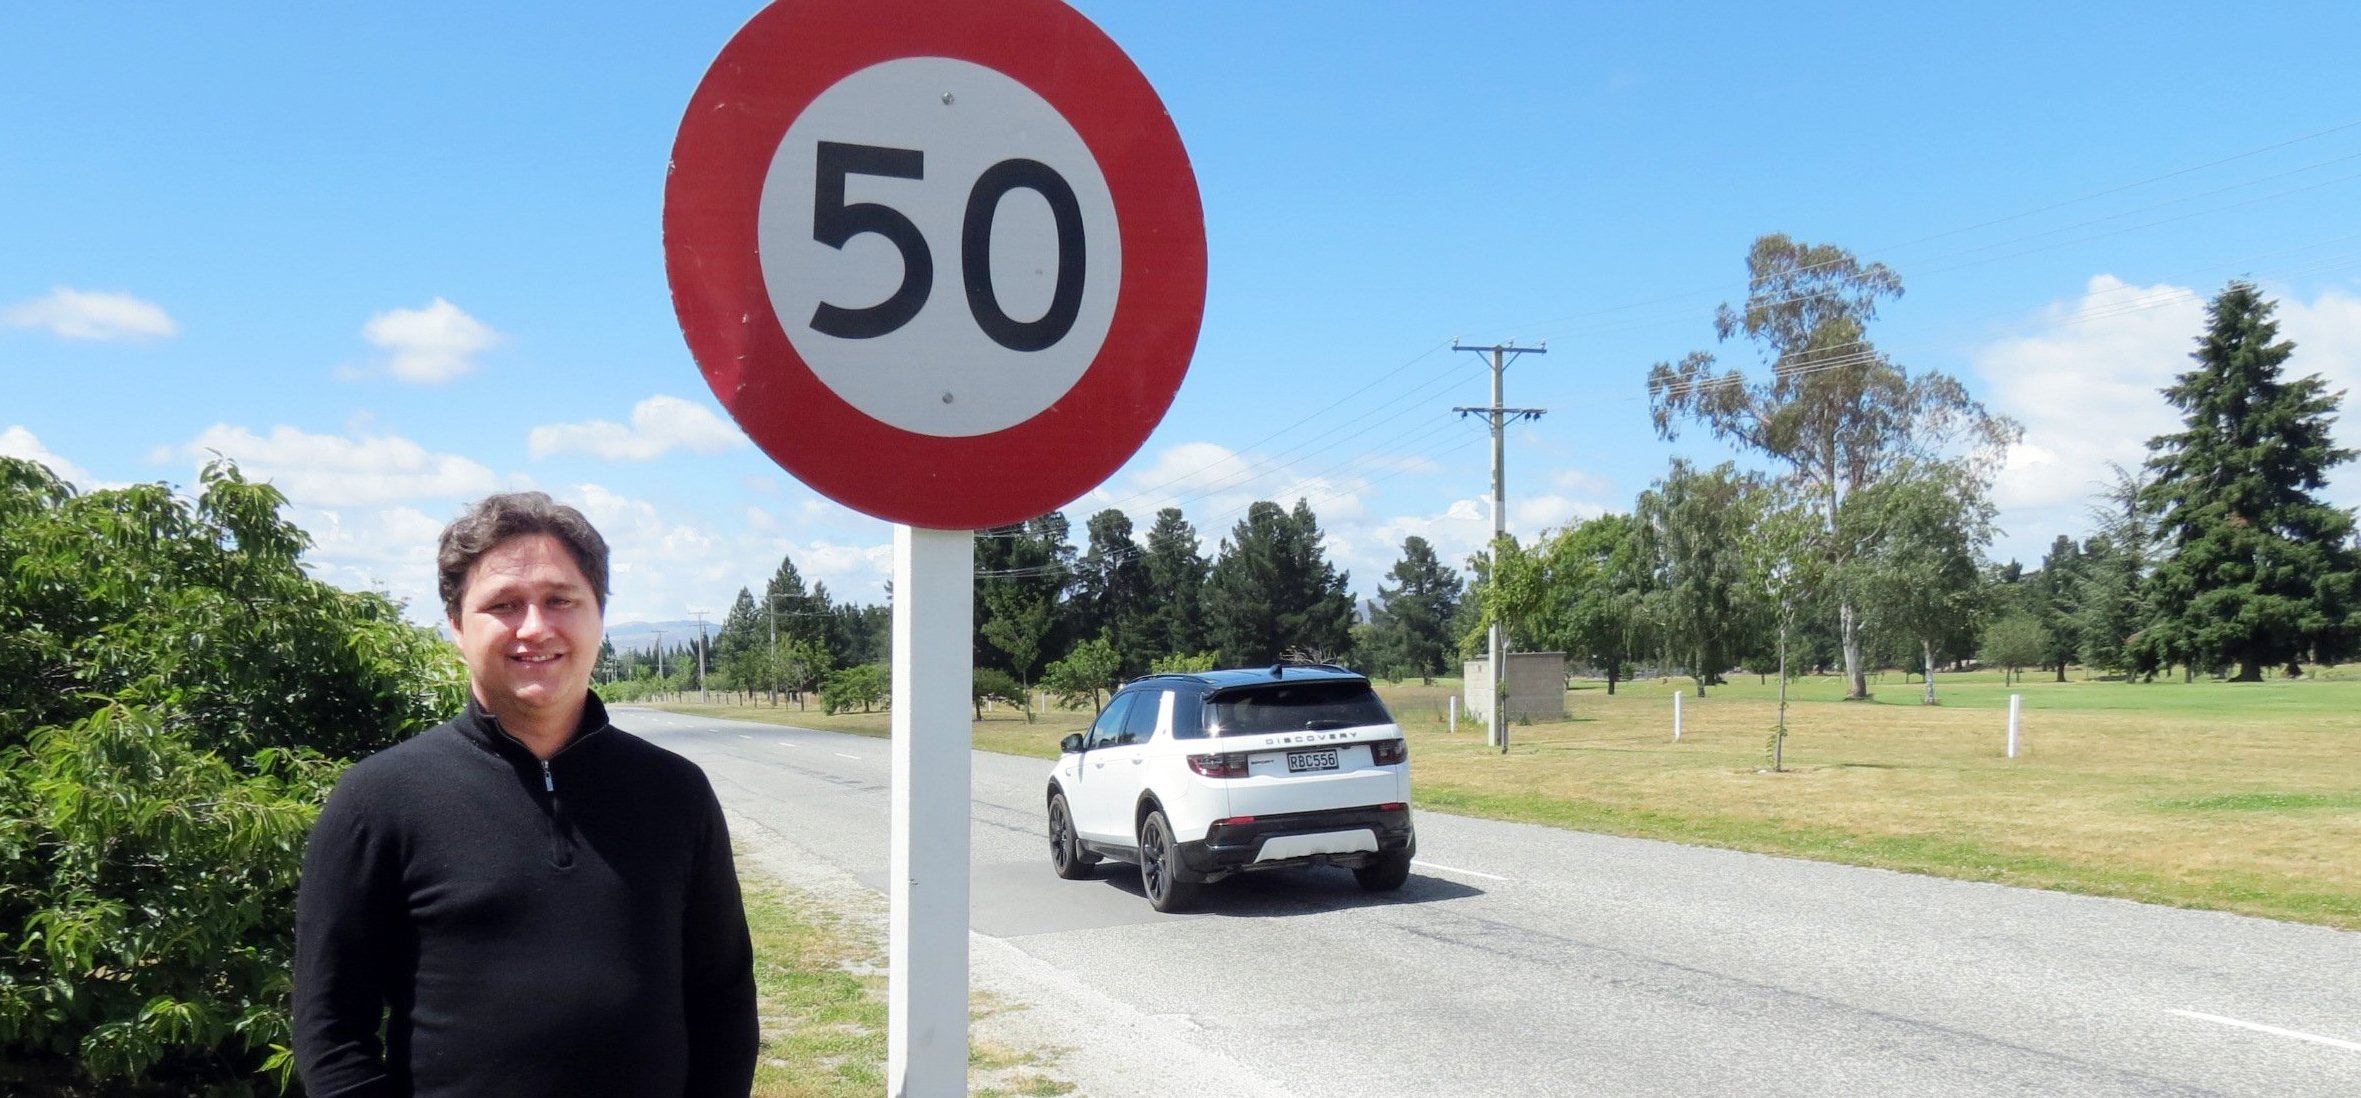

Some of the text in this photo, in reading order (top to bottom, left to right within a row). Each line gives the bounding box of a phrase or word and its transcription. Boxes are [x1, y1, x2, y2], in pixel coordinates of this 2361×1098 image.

[809, 140, 1086, 352] 50
[1265, 732, 1357, 745] DISCOVERY
[1290, 753, 1336, 769] RBC556
